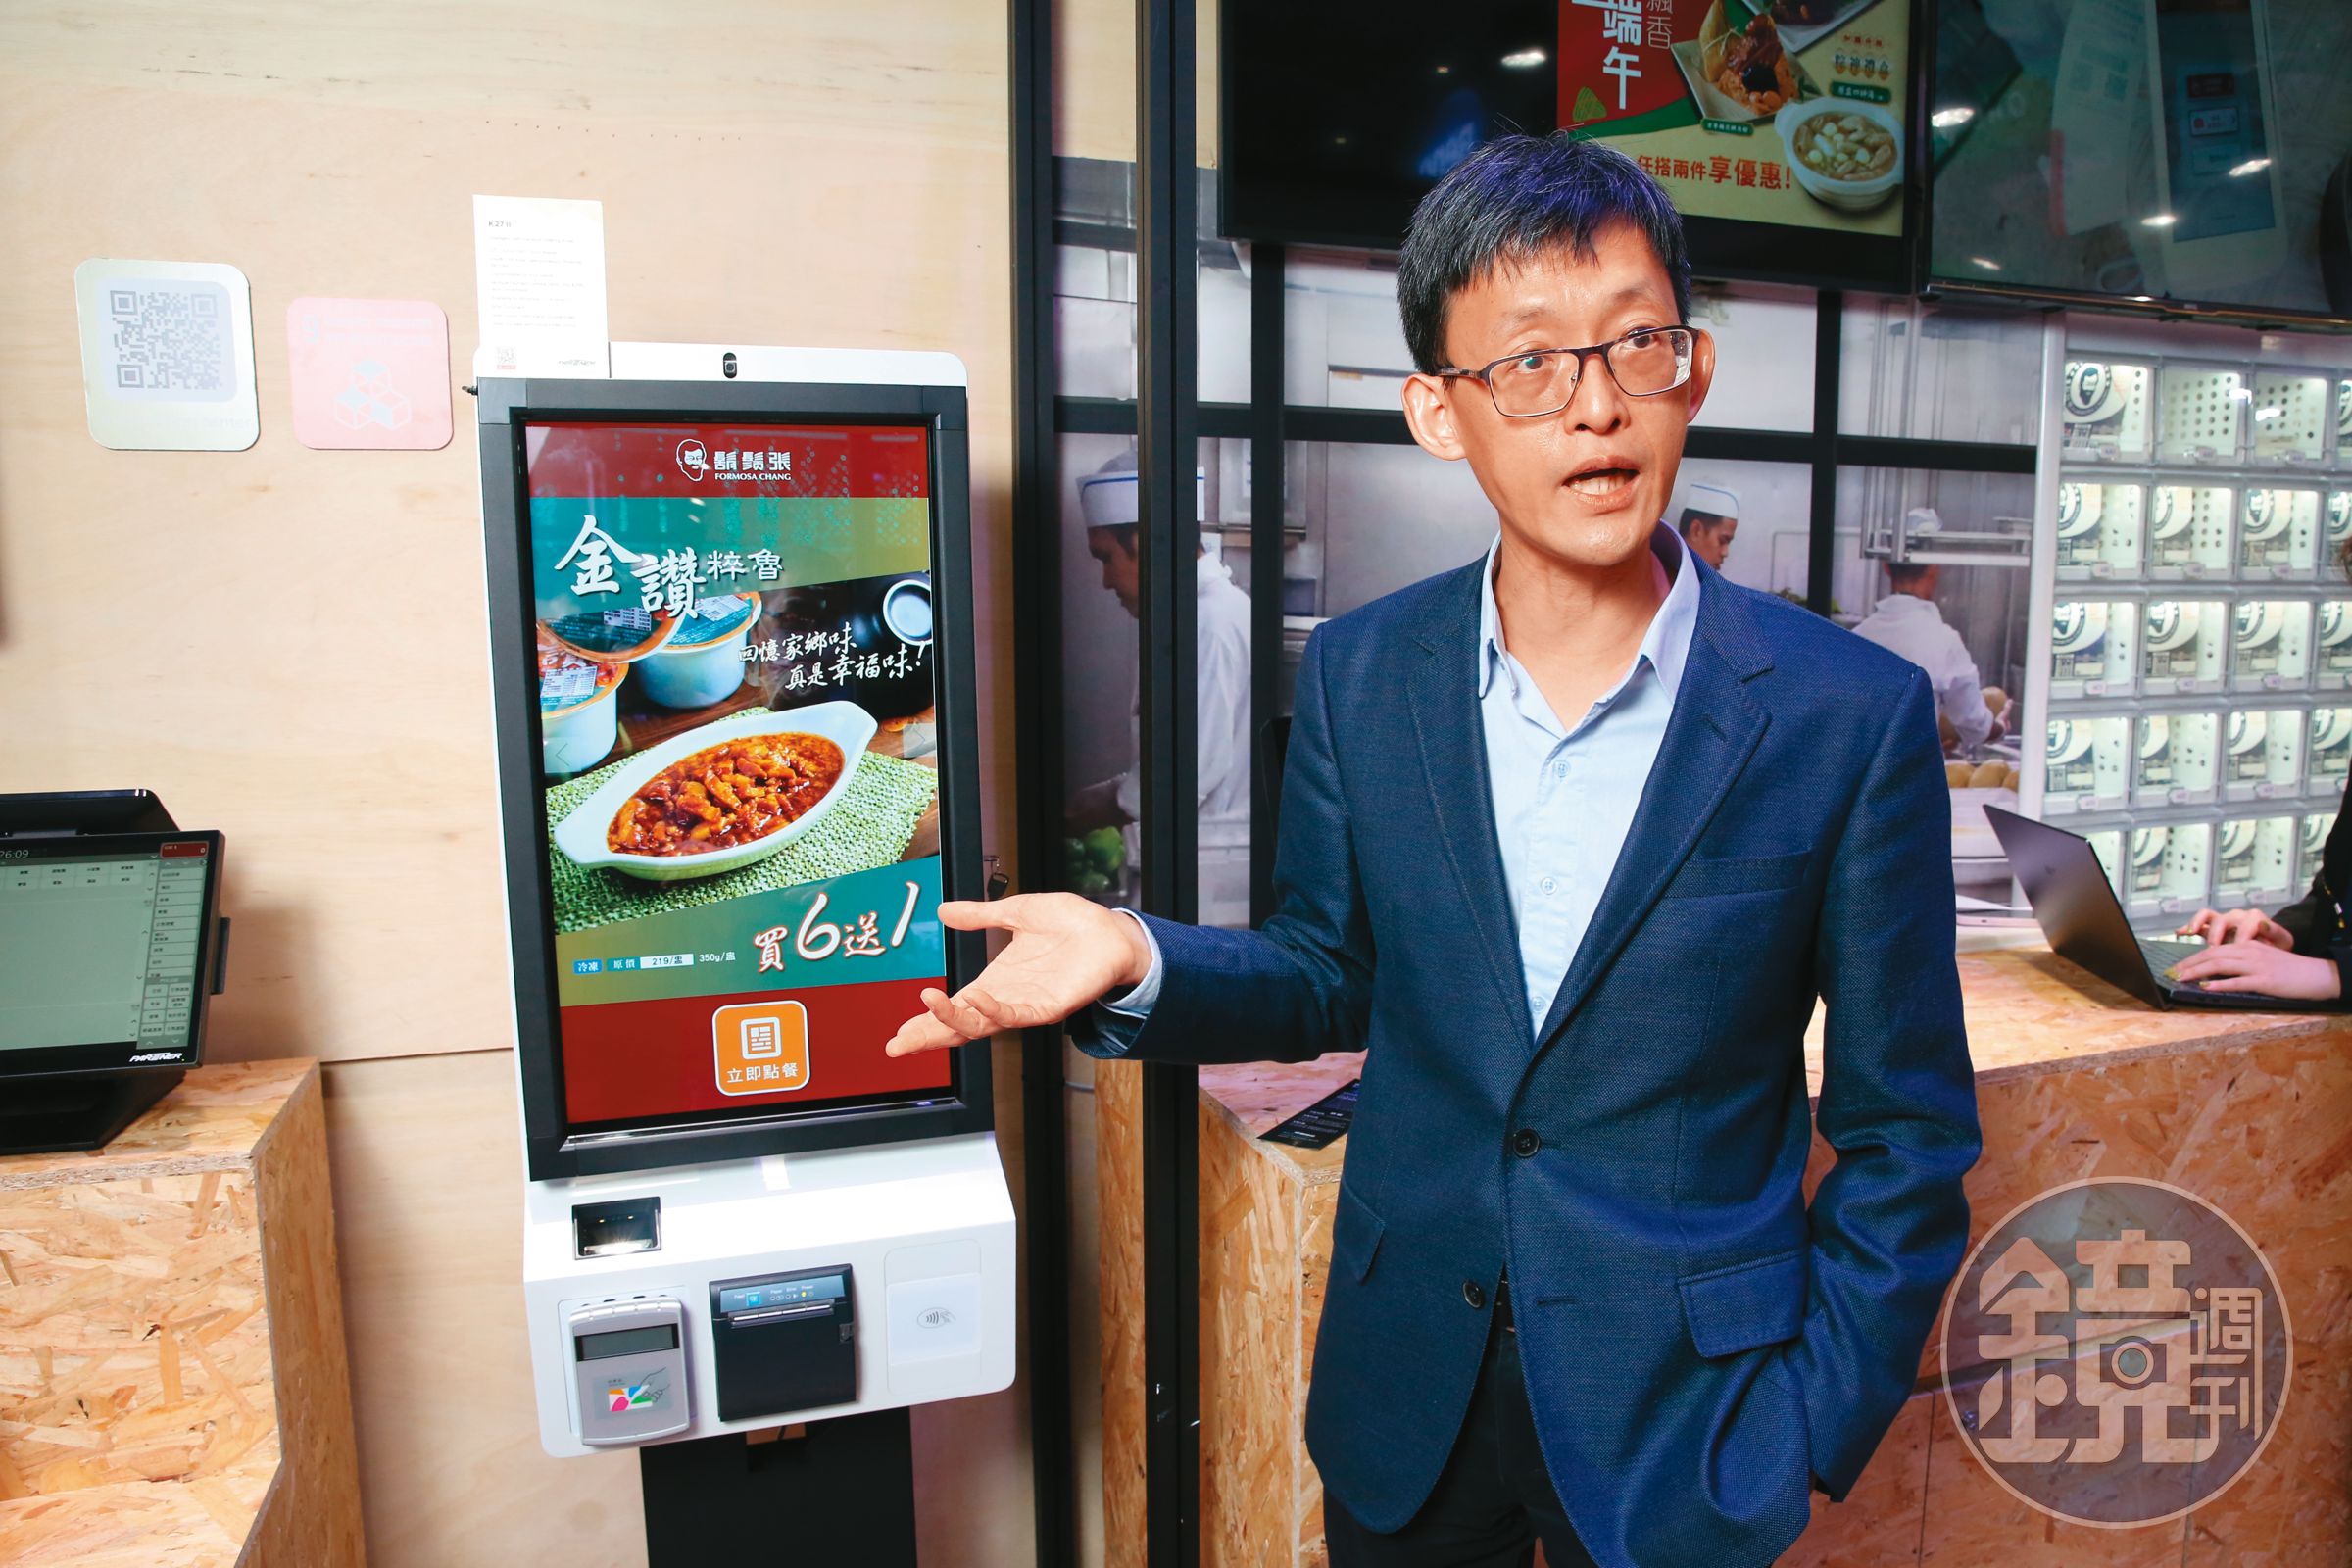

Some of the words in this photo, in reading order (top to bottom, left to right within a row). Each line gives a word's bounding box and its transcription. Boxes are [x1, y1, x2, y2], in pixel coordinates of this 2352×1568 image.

[714, 472, 758, 481] FORMOSA
[759, 472, 792, 481] CHANG
[739, 621, 858, 663] 回憶家鄉味
[784, 640, 926, 691] 真是幸福味!
[753, 880, 920, 974] 買6送1
[726, 1061, 799, 1084] 立即點餐
